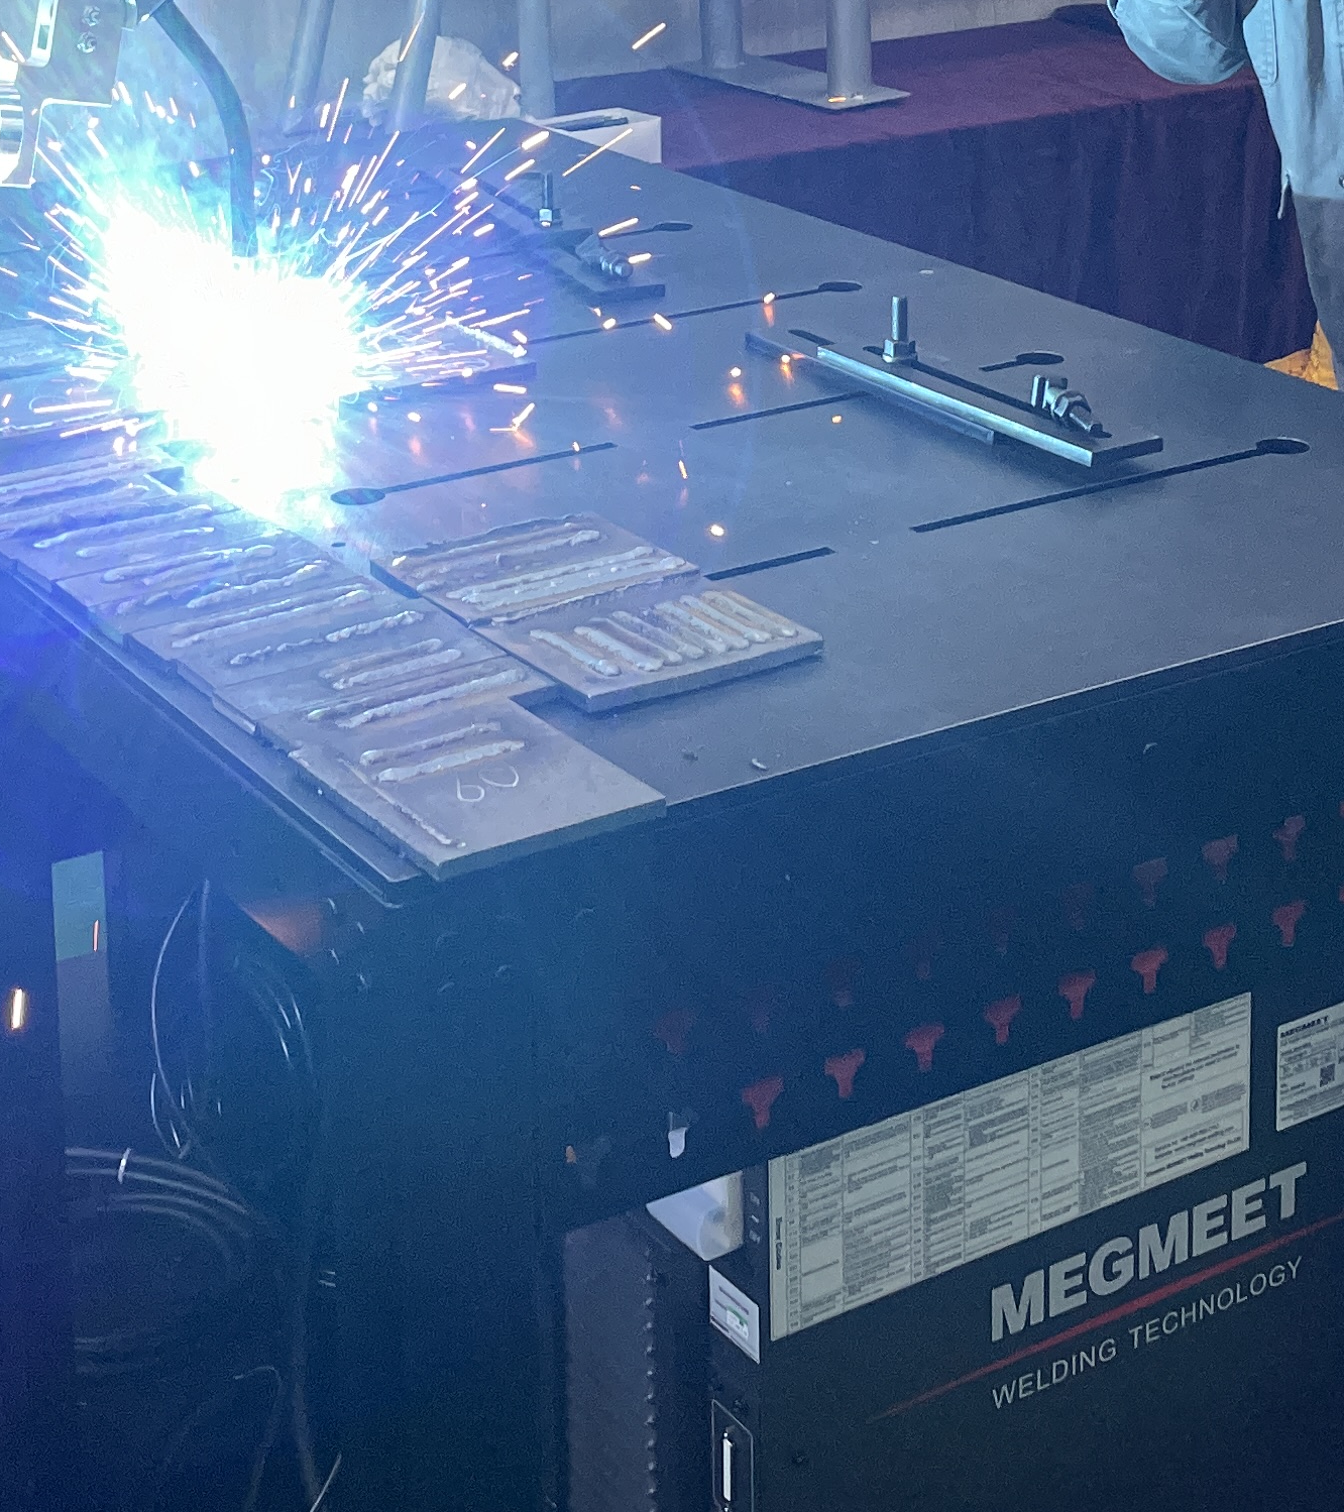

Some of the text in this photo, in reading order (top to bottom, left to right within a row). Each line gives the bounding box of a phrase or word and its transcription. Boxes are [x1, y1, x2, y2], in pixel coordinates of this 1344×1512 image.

[991, 1160, 1308, 1343] MEGMEET
[992, 1255, 1304, 1410] WELDING TECHNOLOGY
